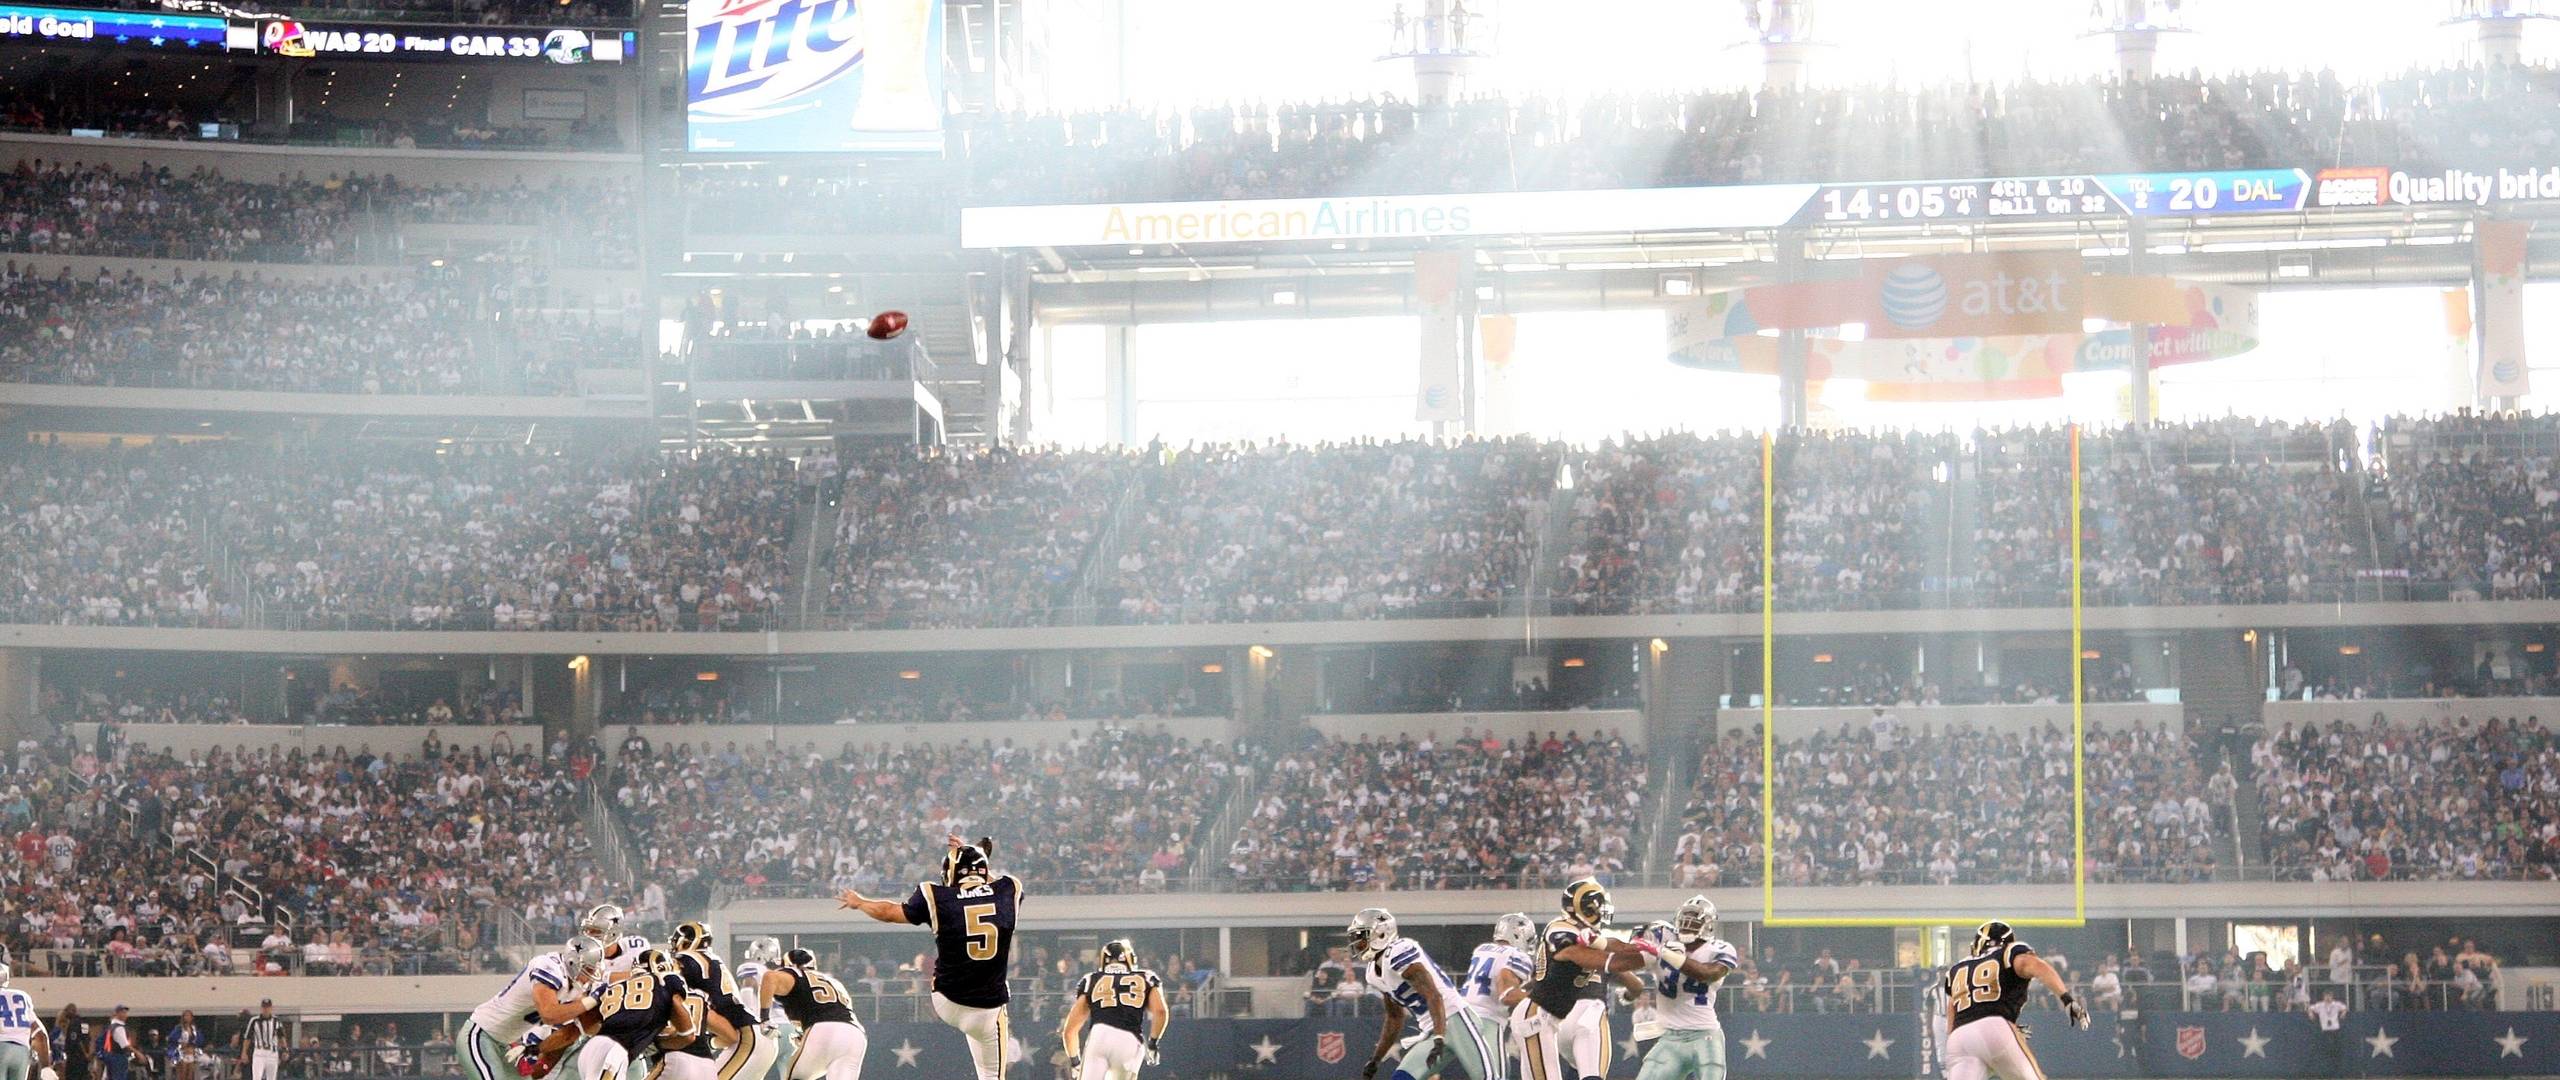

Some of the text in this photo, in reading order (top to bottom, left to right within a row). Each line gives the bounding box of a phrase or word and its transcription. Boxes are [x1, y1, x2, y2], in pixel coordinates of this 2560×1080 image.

[39, 17, 94, 38] Goal
[303, 31, 361, 52] WAS
[363, 33, 396, 53] 20
[450, 35, 506, 56] CAR
[507, 37, 541, 57] 33
[1823, 186, 1946, 220] 14:05
[1949, 185, 1978, 200] QTR
[1990, 179, 2027, 197] 4th
[2060, 178, 2085, 196] 10
[2081, 195, 2106, 213] 32
[2169, 177, 2283, 210] 20 DAL
[2388, 168, 2491, 206] Quality
[1101, 198, 1472, 242] American Airlines
[1956, 198, 1971, 215] 4
[1960, 271, 2068, 316] at&t
[963, 903, 999, 961] 5
[600, 974, 655, 1020] 88
[1091, 974, 1147, 1008] 43
[1951, 960, 2002, 1013] 49
[0, 994, 32, 1028] 42
